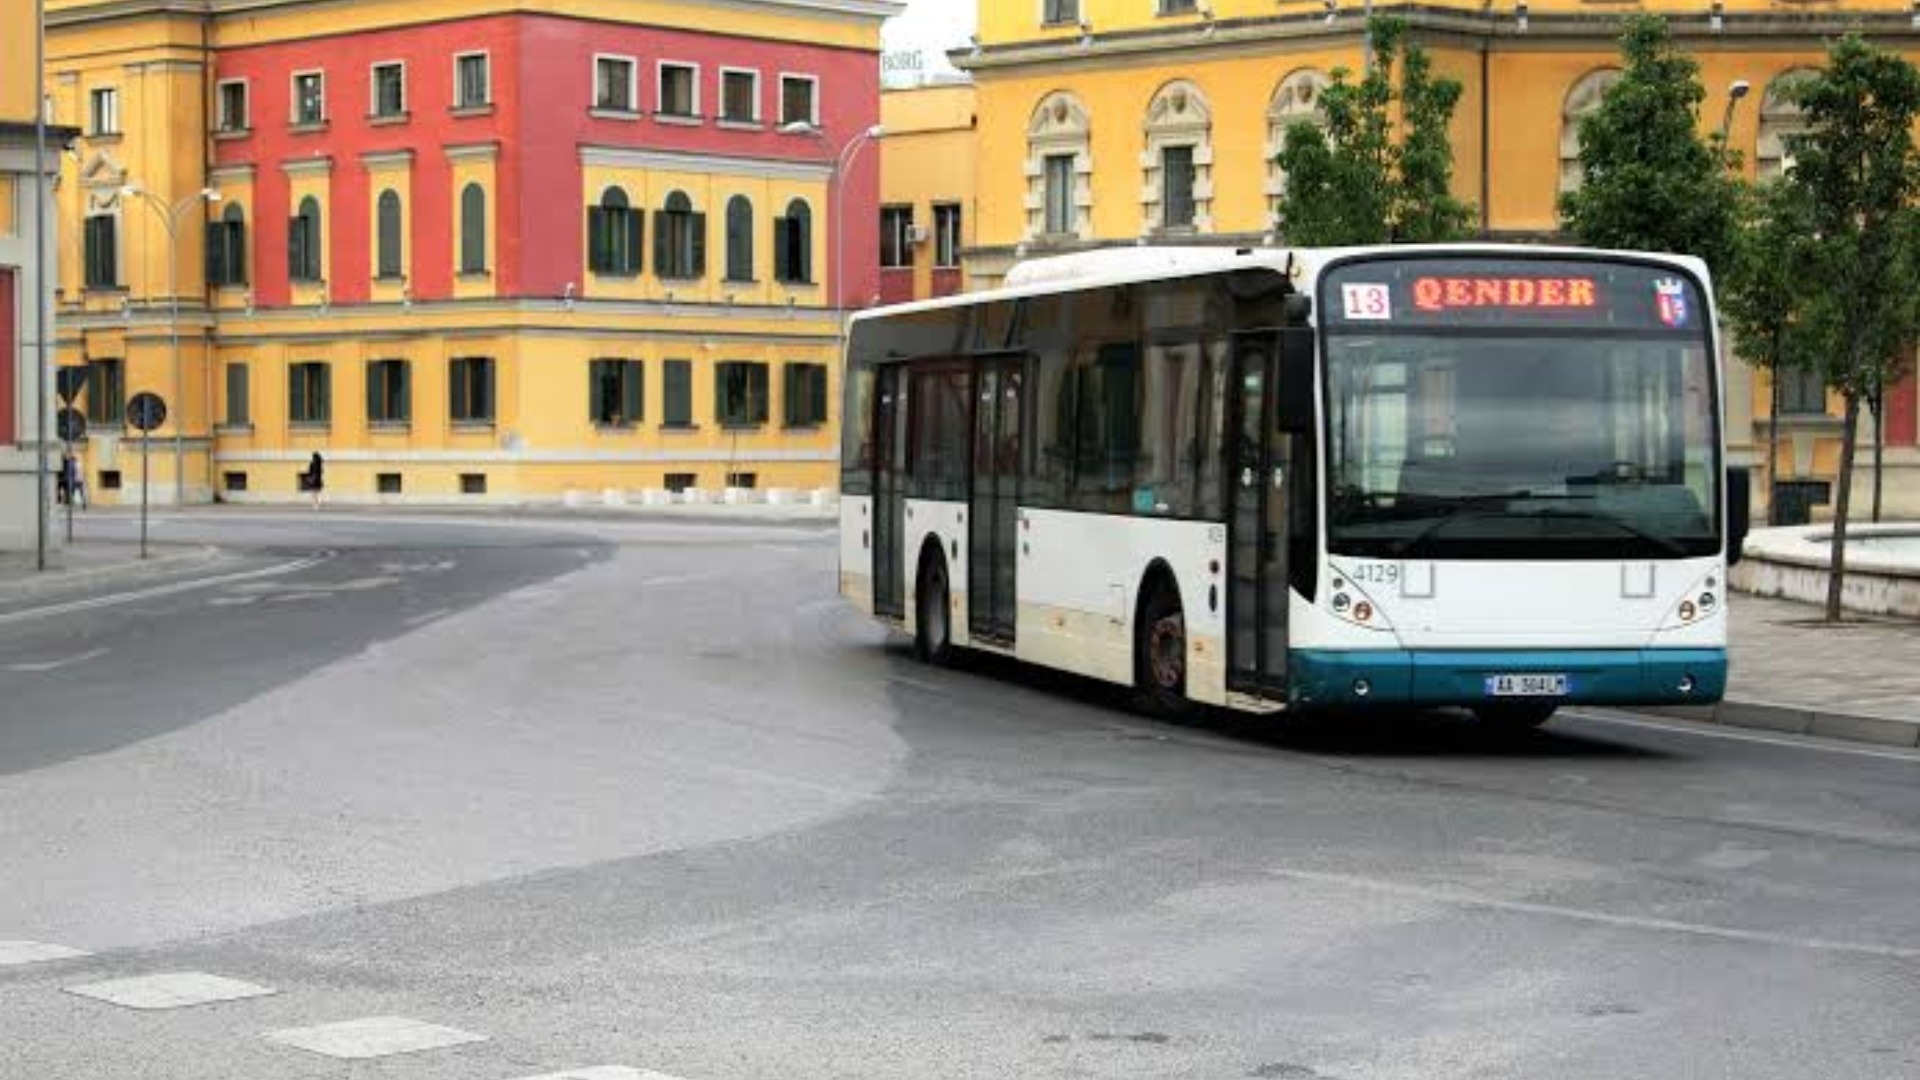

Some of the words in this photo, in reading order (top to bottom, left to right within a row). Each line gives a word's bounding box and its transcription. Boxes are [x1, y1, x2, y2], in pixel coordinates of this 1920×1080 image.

[1347, 286, 1387, 315] 13
[1413, 276, 1595, 311] QENDER
[1352, 563, 1398, 584] 4129
